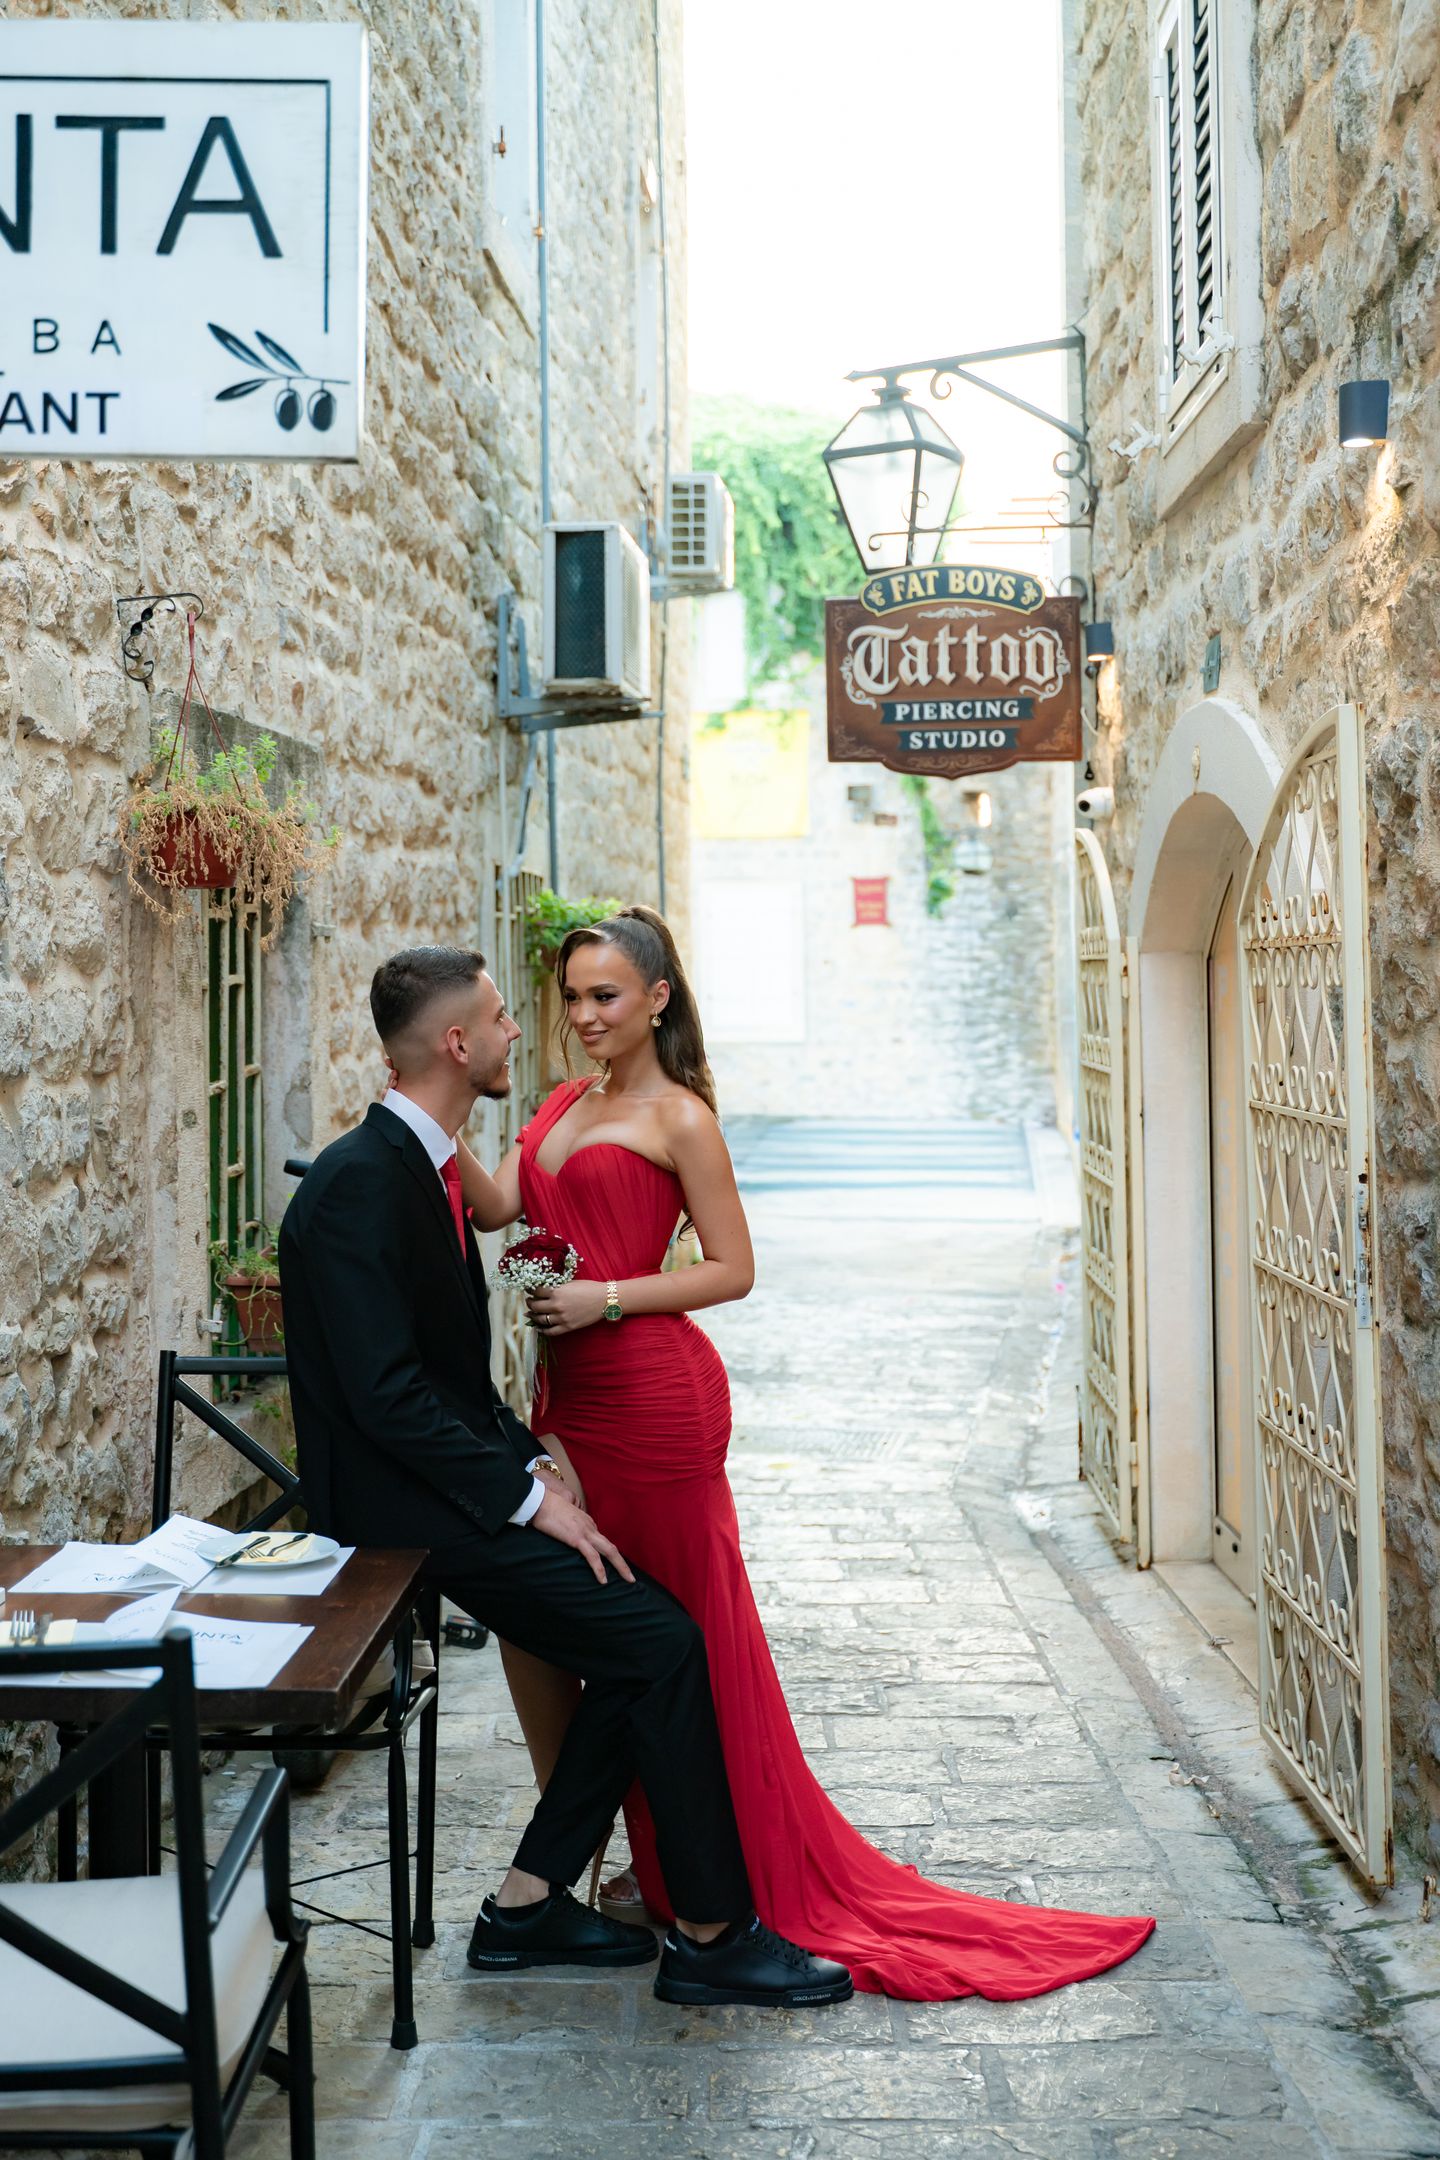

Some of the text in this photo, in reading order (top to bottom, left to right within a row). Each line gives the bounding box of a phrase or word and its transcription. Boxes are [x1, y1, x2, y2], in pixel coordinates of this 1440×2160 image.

[0, 391, 120, 434] ANT
[889, 569, 1016, 602] FAT BOYS
[847, 623, 1055, 696] Tattoo
[894, 700, 1019, 722] PIERCING
[909, 730, 1006, 750] STUDIO
